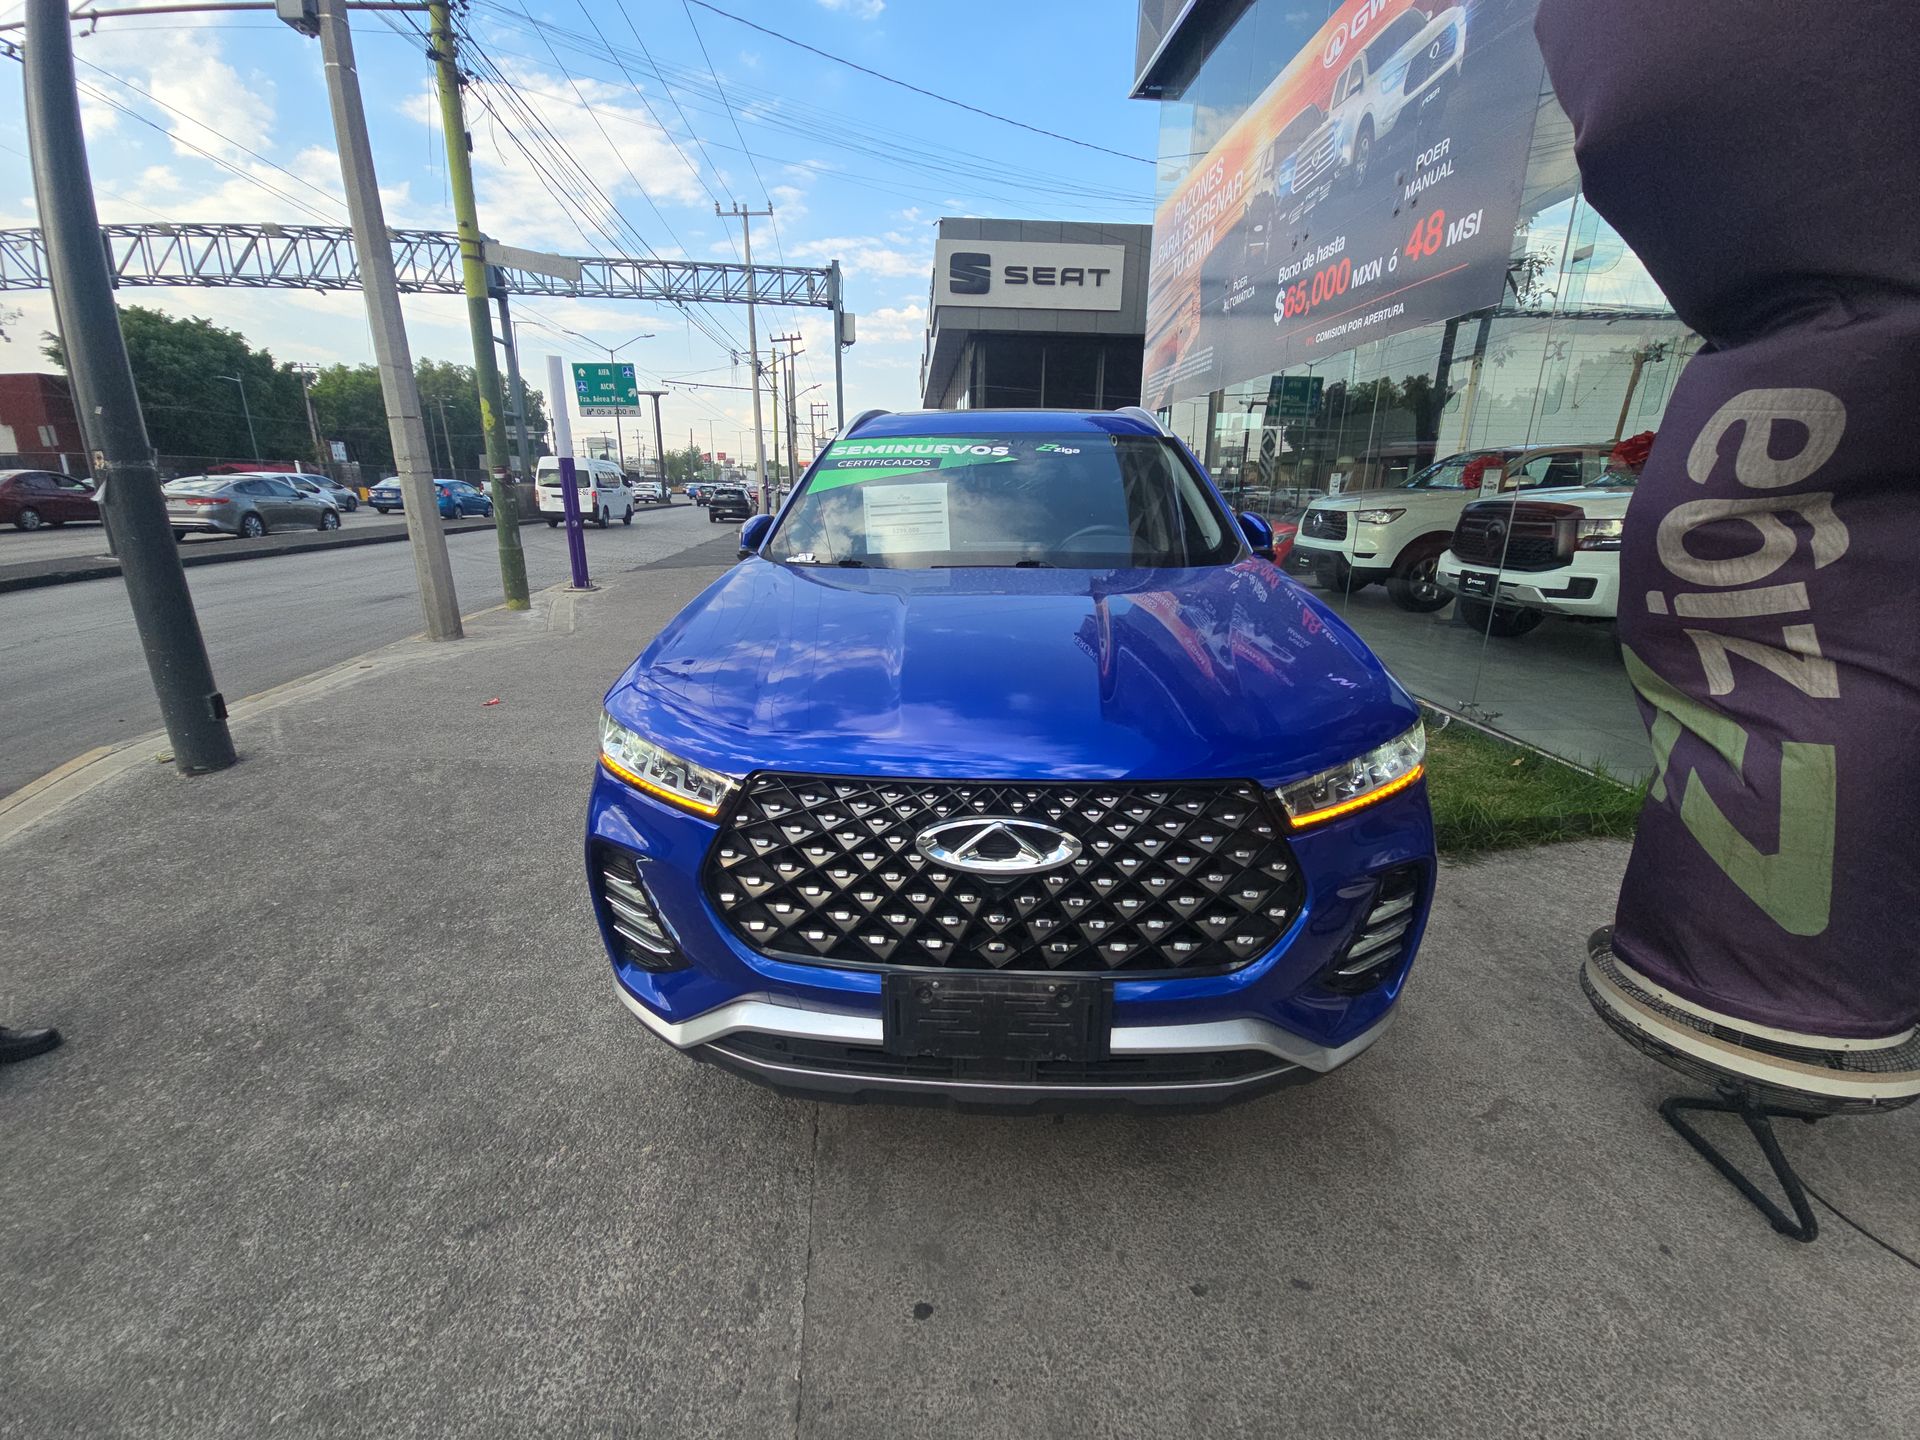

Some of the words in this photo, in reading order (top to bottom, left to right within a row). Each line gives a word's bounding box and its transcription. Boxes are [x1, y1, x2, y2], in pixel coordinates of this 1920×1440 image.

[1350, 0, 1392, 39] GW
[1416, 137, 1451, 173] POER
[1174, 157, 1225, 226] RAZONES
[1404, 159, 1455, 201] MANUAL
[1158, 229, 1181, 263] PARA
[1182, 169, 1244, 245] ESTRENAR
[1172, 254, 1186, 279] TU
[1186, 225, 1216, 268] GWM
[1273, 256, 1352, 326] $65,000
[1351, 257, 1383, 289] MXN
[1388, 247, 1399, 272] ó
[1404, 209, 1445, 261] 48
[1446, 208, 1484, 248] MSI
[1278, 261, 1301, 284] Bono
[1302, 251, 1315, 271] de
[1316, 235, 1346, 264] hasta
[1004, 266, 1110, 287] SEAT
[1315, 324, 1348, 343] COMISION
[1347, 318, 1363, 332] POR
[1363, 302, 1405, 327] APERTURA
[830, 444, 1009, 456] SEMINUEVOS
[837, 459, 931, 468] CERTIFICADOS
[1053, 447, 1081, 455] ziga
[1645, 387, 1850, 699] ziga
